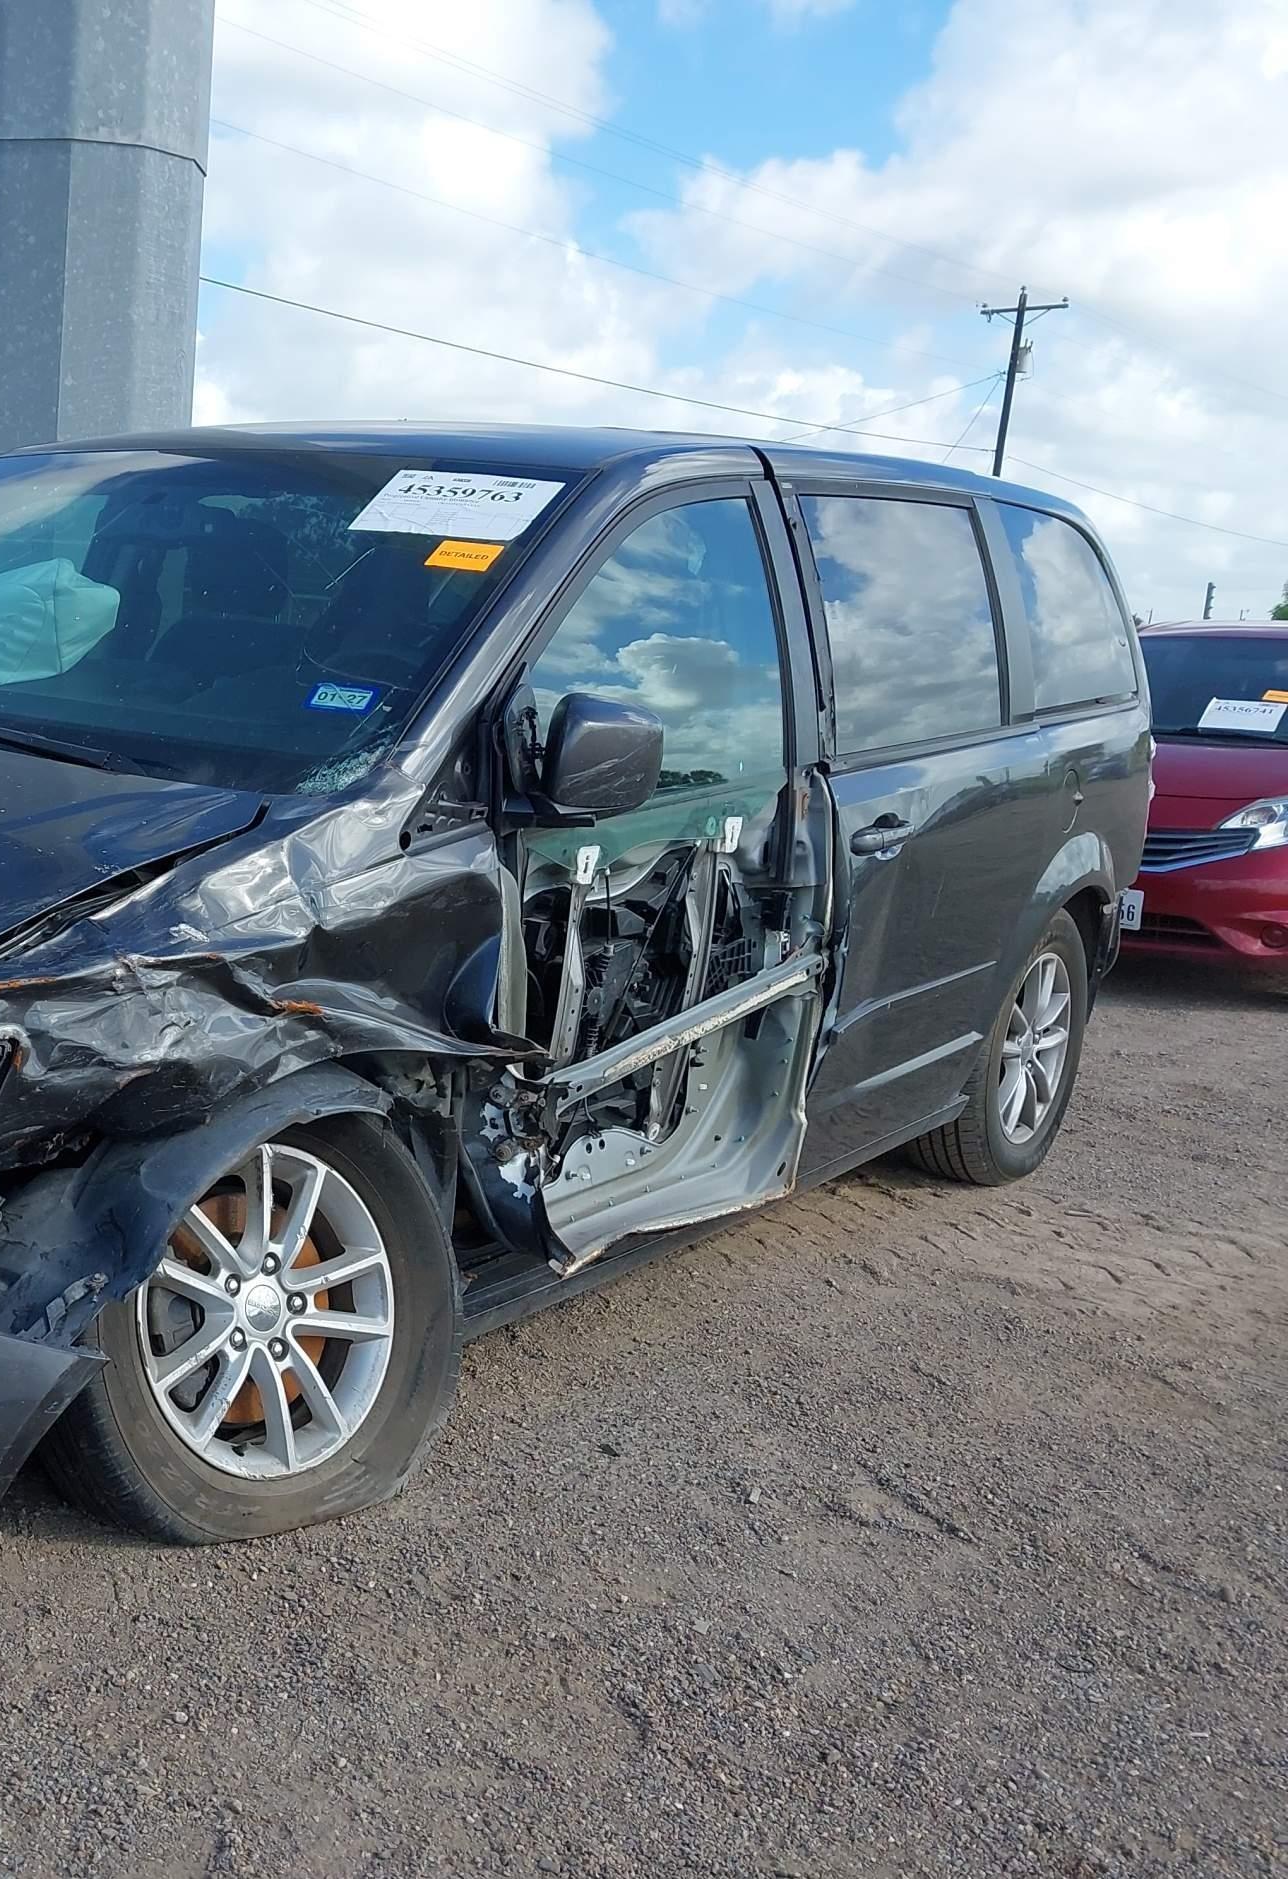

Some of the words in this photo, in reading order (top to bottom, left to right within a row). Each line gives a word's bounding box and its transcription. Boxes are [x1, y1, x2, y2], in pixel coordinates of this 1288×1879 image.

[398, 483, 523, 503] 45359763
[439, 550, 489, 561] DETAILED
[318, 691, 337, 702] 01
[347, 694, 368, 705] 27
